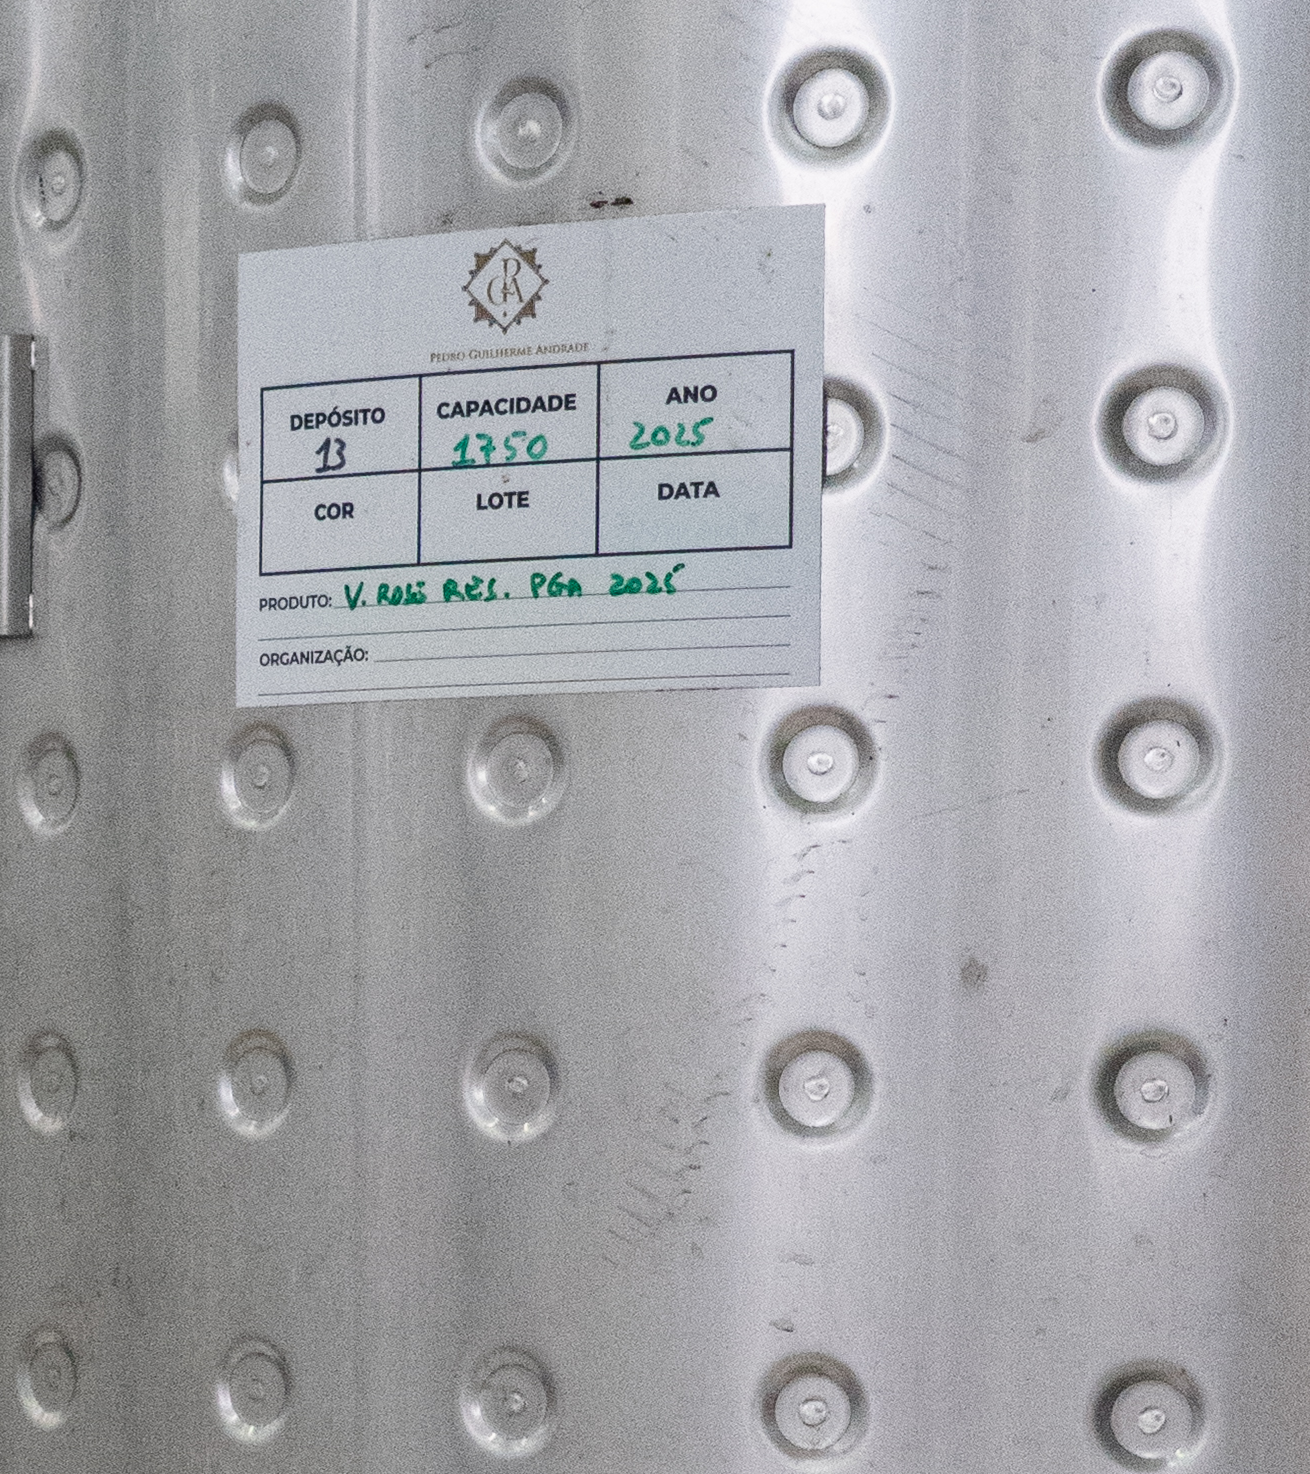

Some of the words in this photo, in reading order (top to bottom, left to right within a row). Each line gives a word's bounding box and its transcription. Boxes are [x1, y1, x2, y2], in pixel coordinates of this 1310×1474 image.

[289, 406, 386, 431] DEPÓSITO
[436, 393, 577, 419] CAPACIDADE
[665, 384, 718, 405] ANO
[315, 436, 347, 474] 13
[451, 430, 549, 467] 1750
[628, 416, 715, 450] 2025
[314, 502, 355, 521] COR
[476, 490, 530, 511] LOTE
[657, 481, 721, 500] DATA
[609, 562, 685, 596] 2025
[259, 594, 332, 612] PRODUTO:
[259, 644, 369, 666] ORGANIZAÇÃO:
